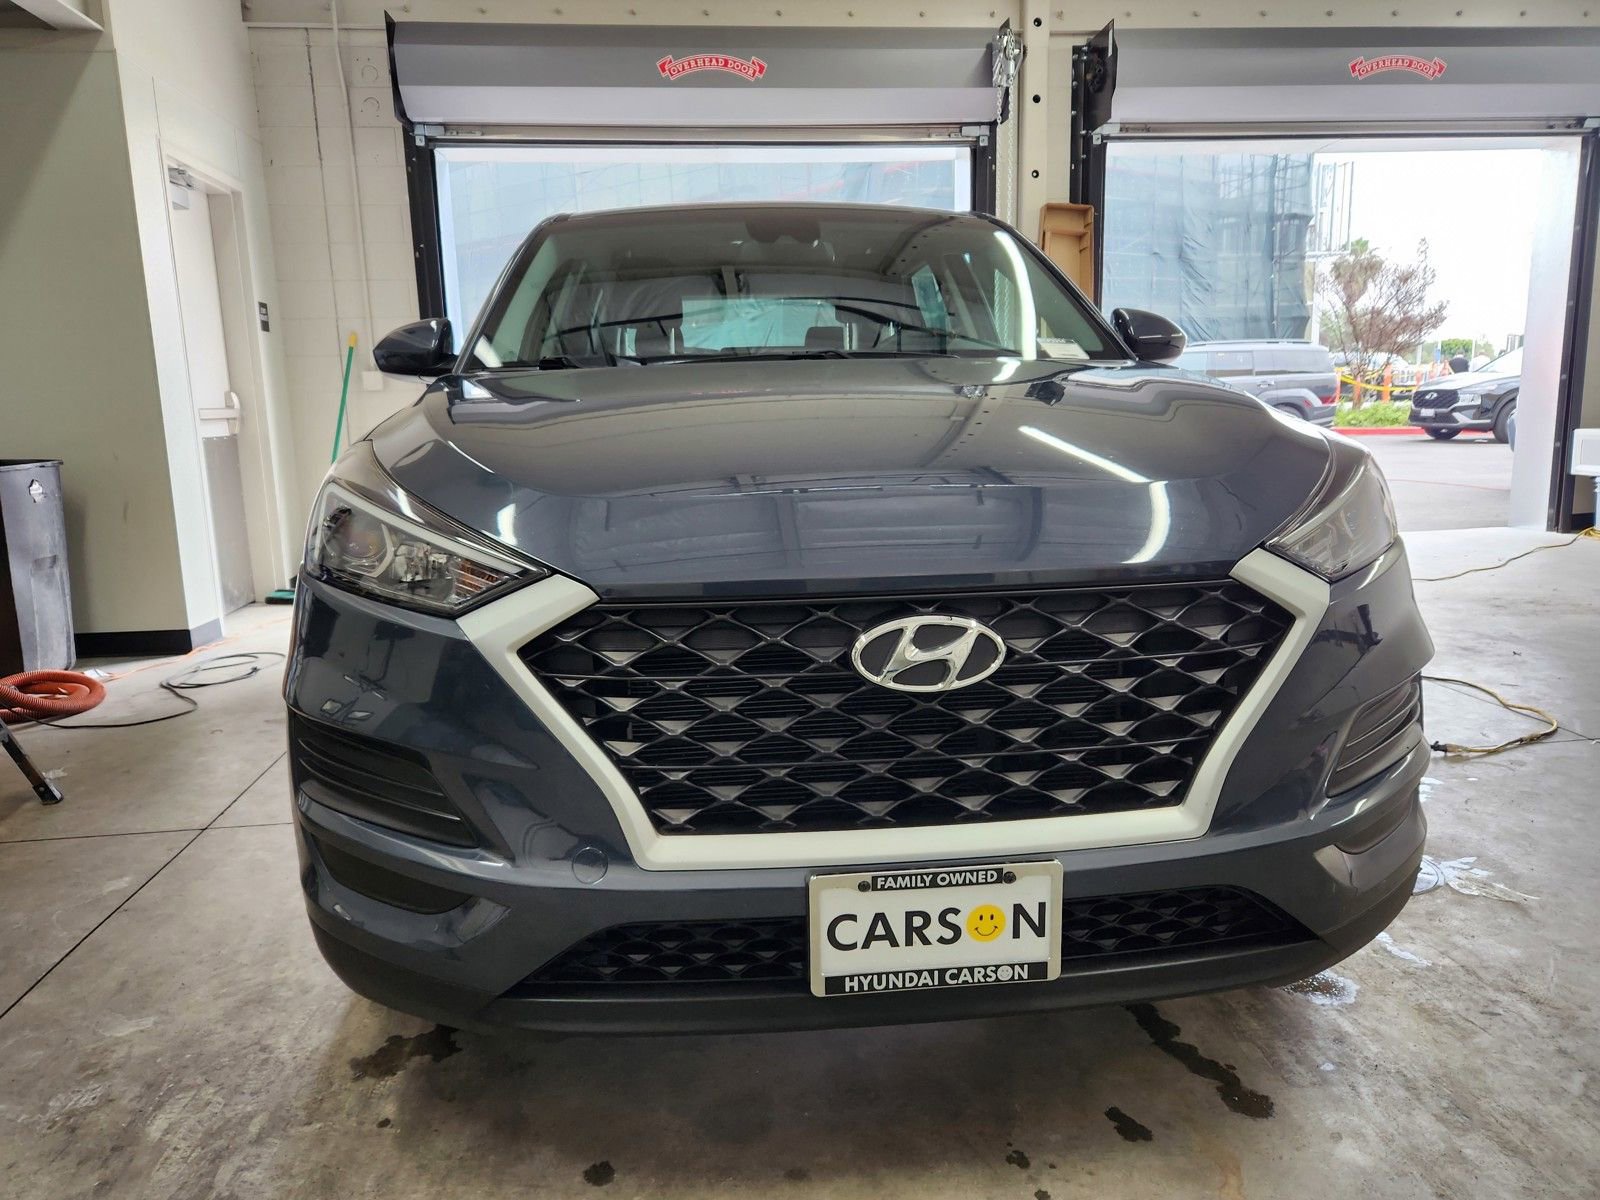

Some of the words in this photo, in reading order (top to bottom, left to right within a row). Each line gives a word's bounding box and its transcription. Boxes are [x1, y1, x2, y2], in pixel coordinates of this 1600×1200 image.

[670, 58, 725, 74] OVERHEAD
[727, 60, 755, 77] DOOR
[1359, 59, 1410, 75] OVERHEAD
[1412, 60, 1435, 76] DOOR
[877, 874, 933, 890] FAMILY
[936, 870, 998, 886] OWNED
[844, 970, 939, 993] HYUNDAI
[944, 964, 1029, 985] CARSON
